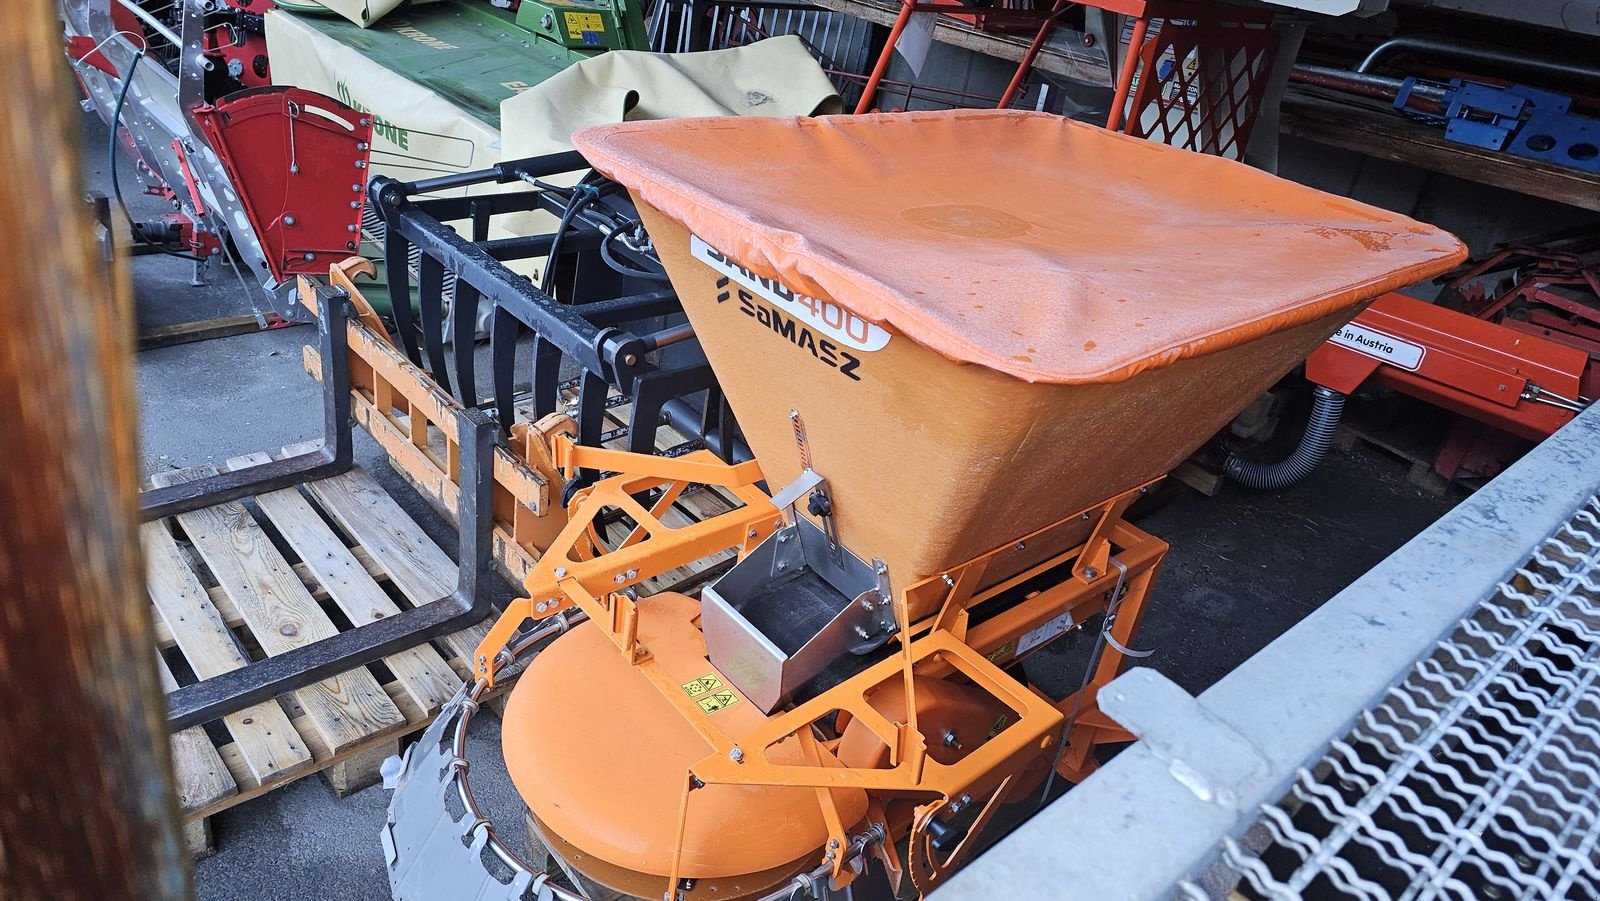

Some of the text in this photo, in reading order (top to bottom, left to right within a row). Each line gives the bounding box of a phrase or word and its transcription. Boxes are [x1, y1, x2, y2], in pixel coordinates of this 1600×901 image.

[352, 99, 409, 151] ONE
[1344, 329, 1354, 341] in
[1355, 334, 1393, 354] Austria
